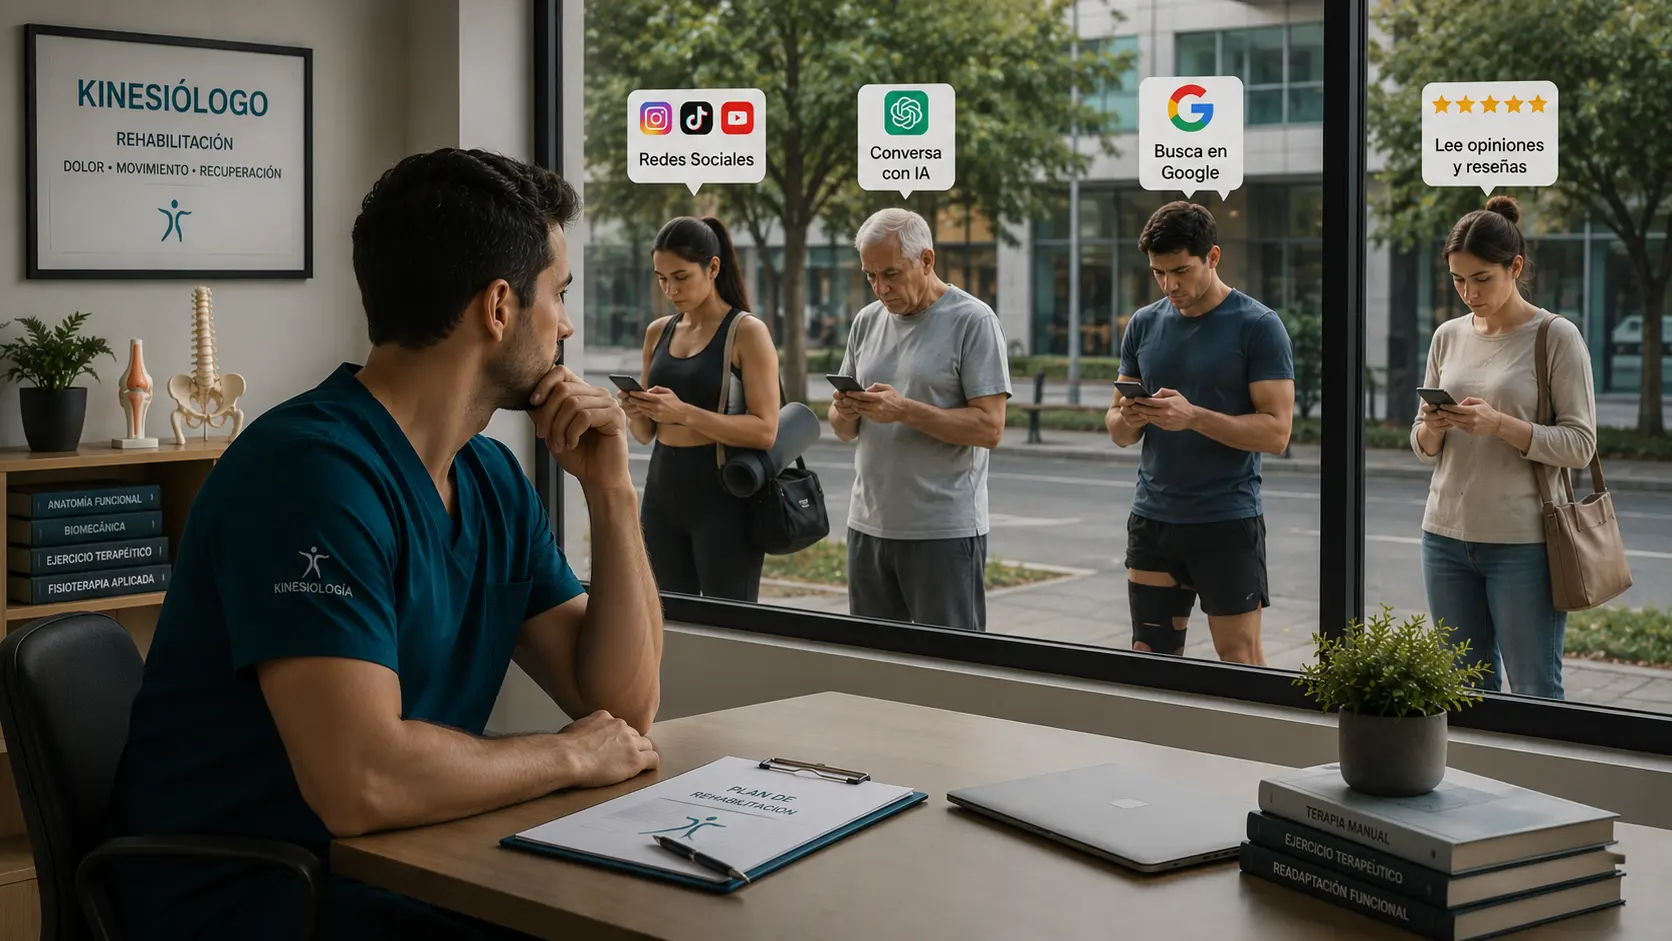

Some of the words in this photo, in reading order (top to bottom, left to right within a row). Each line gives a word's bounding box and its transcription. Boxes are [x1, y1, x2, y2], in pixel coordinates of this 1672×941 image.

[77, 78, 269, 117] KINESIÓLOGO
[116, 131, 234, 151] REHABILITACIÓN
[63, 160, 104, 173] DOLOR
[116, 162, 189, 176] MOVIMIENTO
[199, 164, 282, 179] RECUPERACIÓN
[47, 495, 93, 510] ANATOMÍA
[94, 494, 143, 507] FUNCIONAL
[64, 521, 126, 536] BIOMECÁNICA
[46, 552, 94, 566] EJERCICIO
[48, 578, 110, 594] FISIOTERAPIA
[111, 573, 155, 588] APLICADA
[274, 581, 353, 598] KINESIOLOGÍA
[726, 786, 772, 798] PLAN
[770, 793, 797, 803] DE
[1306, 805, 1345, 829] TERAPIA
[1347, 819, 1390, 846] MANUAL
[1285, 832, 1334, 860] EJERCICIO
[1273, 861, 1348, 899] READAPTACIÓN
[1350, 888, 1410, 922] FUNCIONAL
